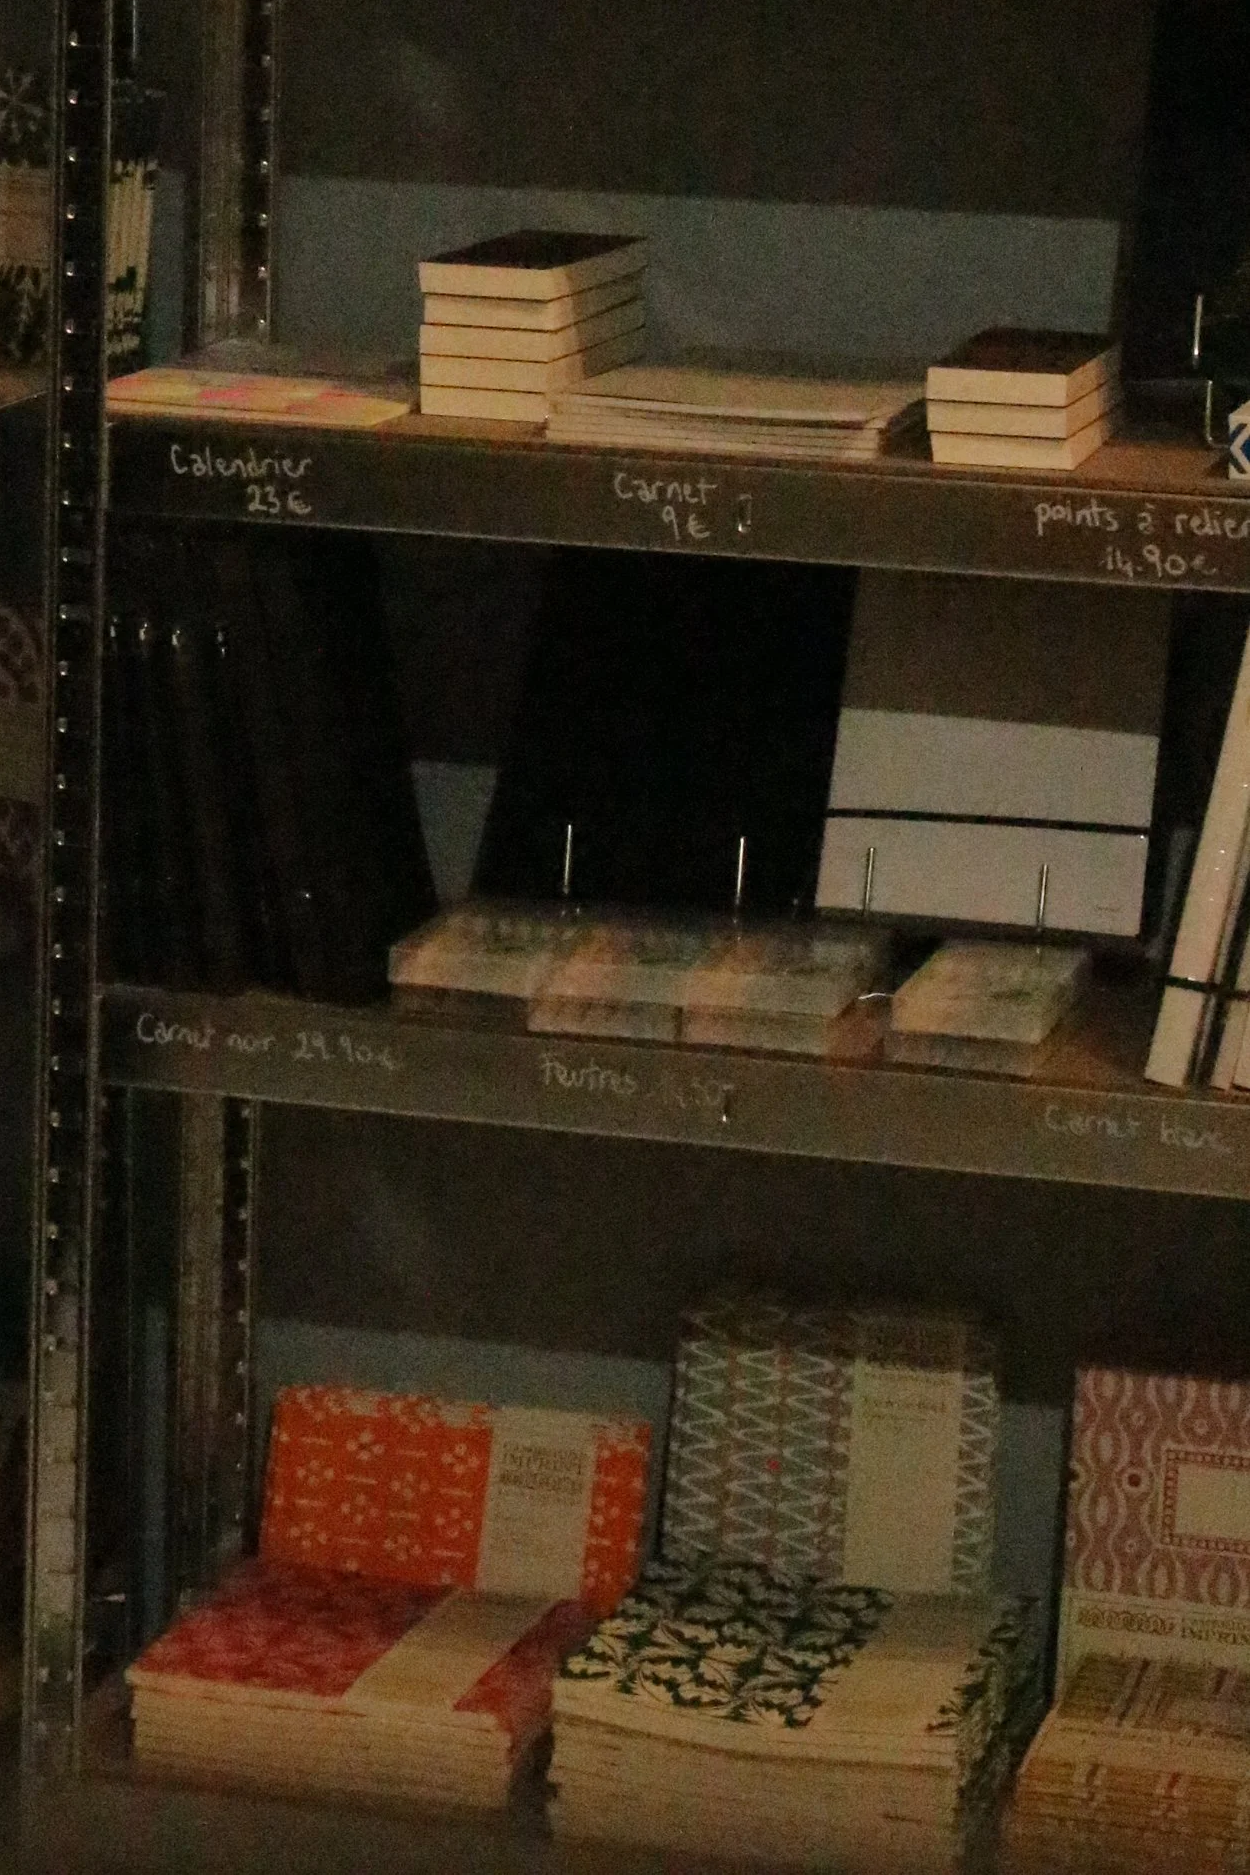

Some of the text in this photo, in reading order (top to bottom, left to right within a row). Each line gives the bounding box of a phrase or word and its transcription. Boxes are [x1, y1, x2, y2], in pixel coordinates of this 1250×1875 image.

[170, 443, 313, 477] Calendrier
[614, 471, 717, 505] Carnet
[1034, 498, 1119, 537] points
